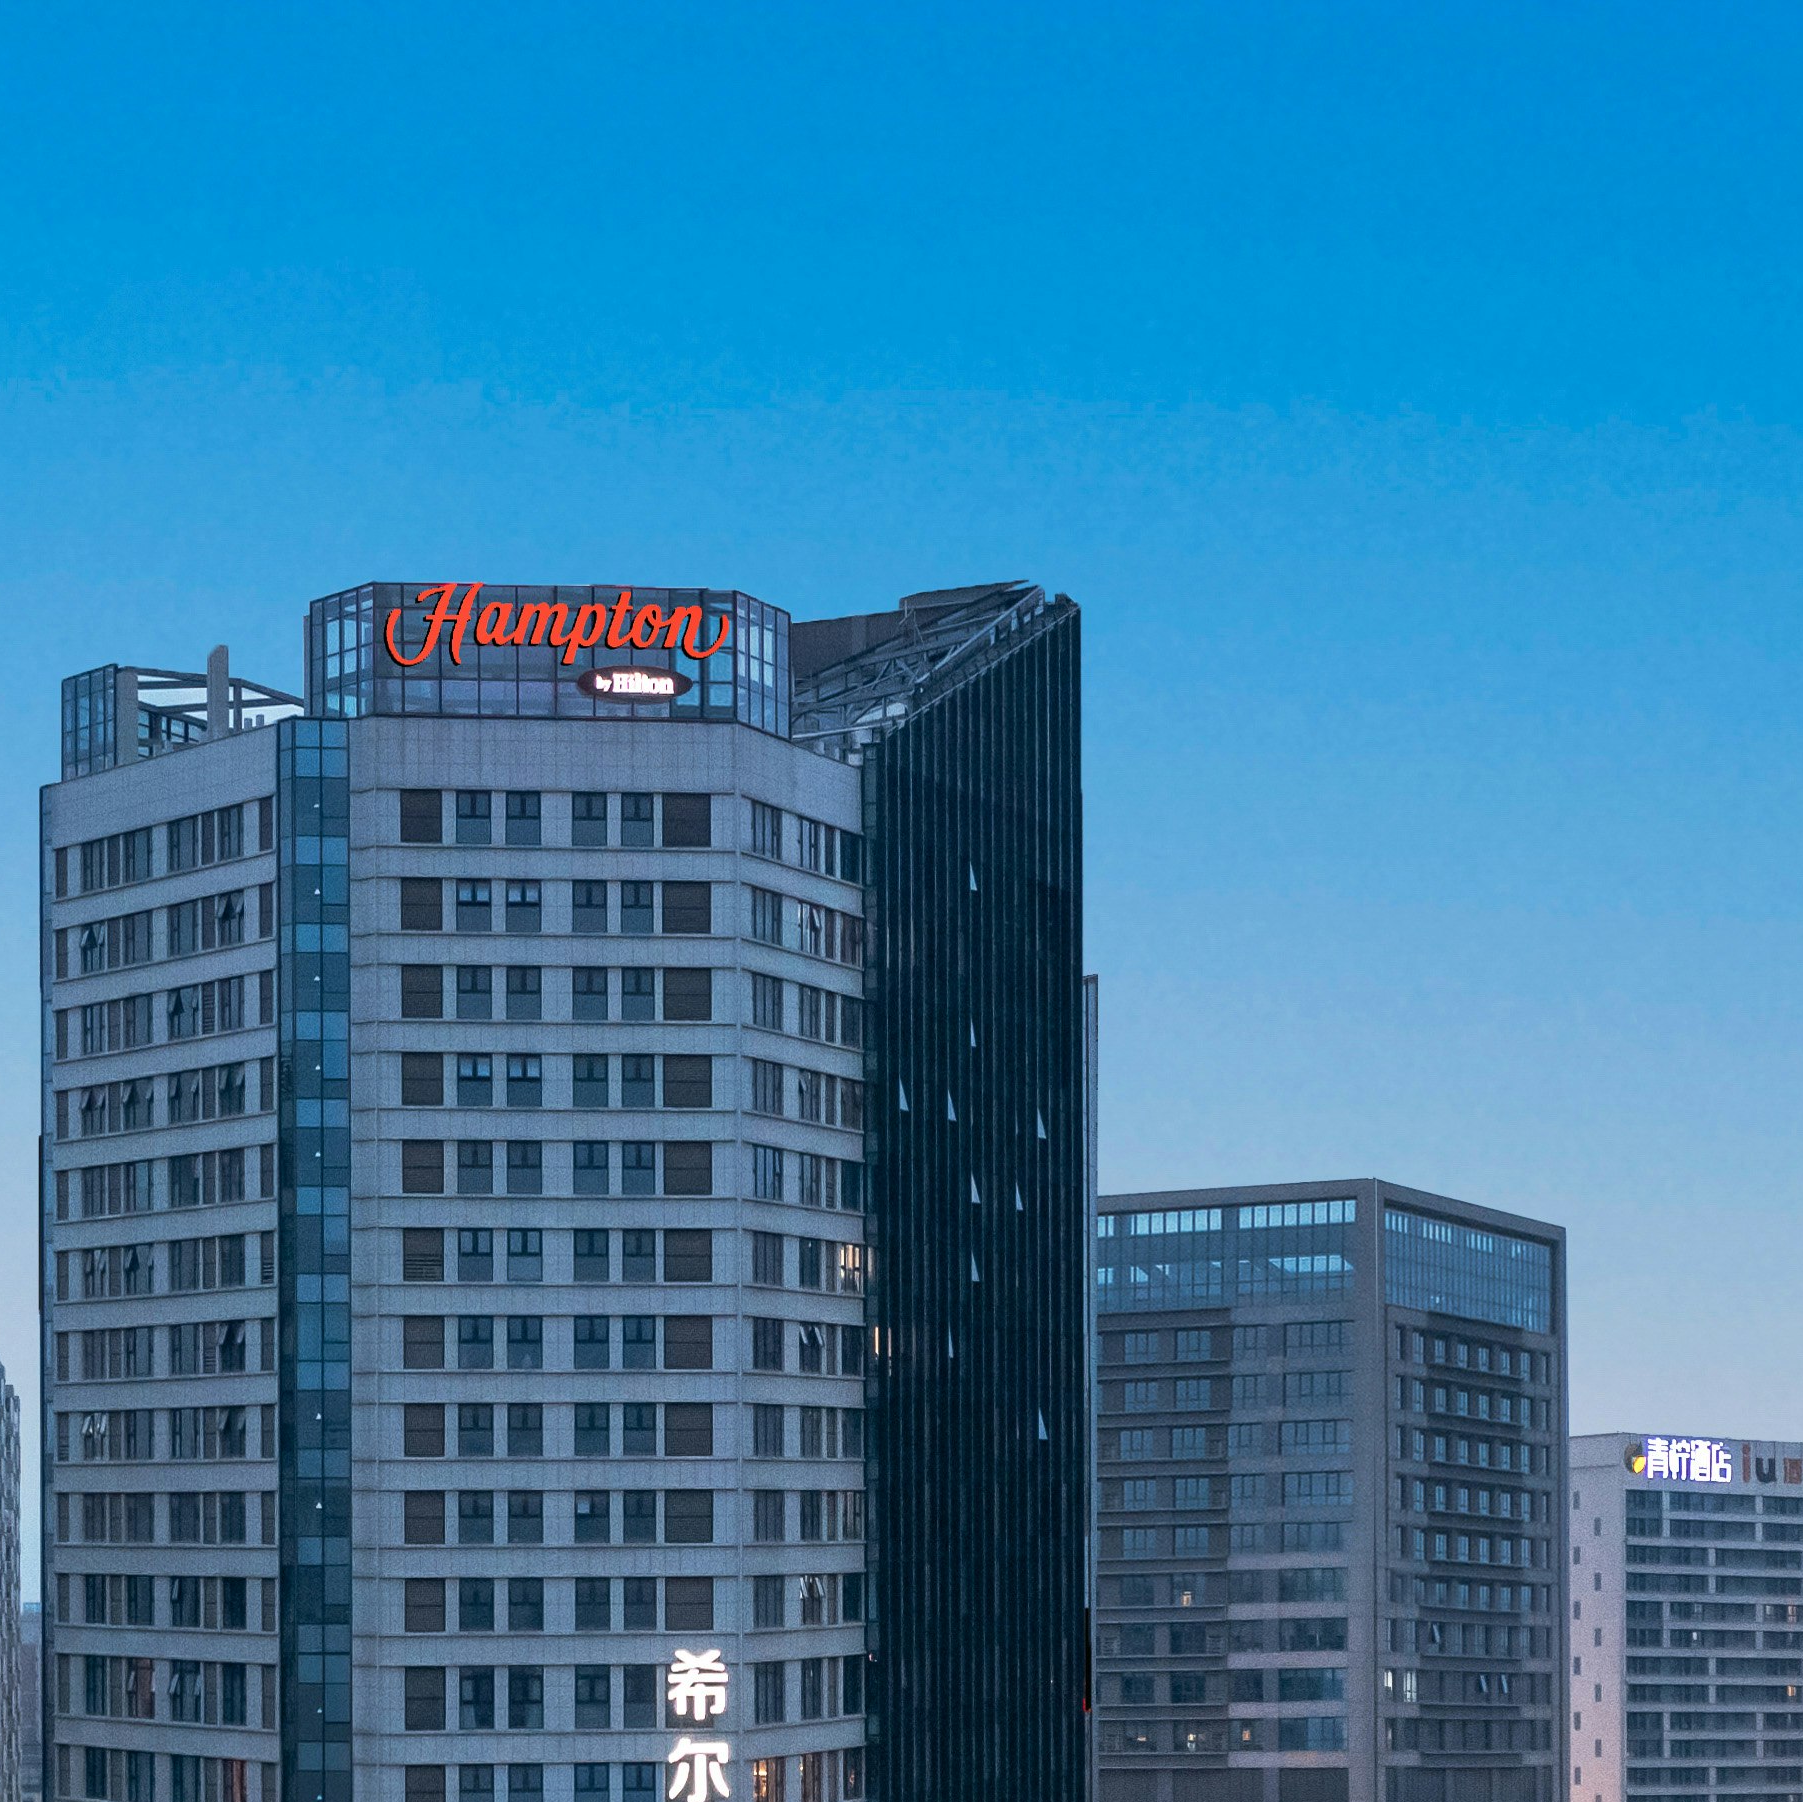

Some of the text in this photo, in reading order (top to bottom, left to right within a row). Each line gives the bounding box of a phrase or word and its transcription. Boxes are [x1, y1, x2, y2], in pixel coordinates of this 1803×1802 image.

[385, 582, 729, 666] Hampton
[595, 672, 674, 694] by Hilton
[1647, 1438, 1732, 1483] 青柠酒店
